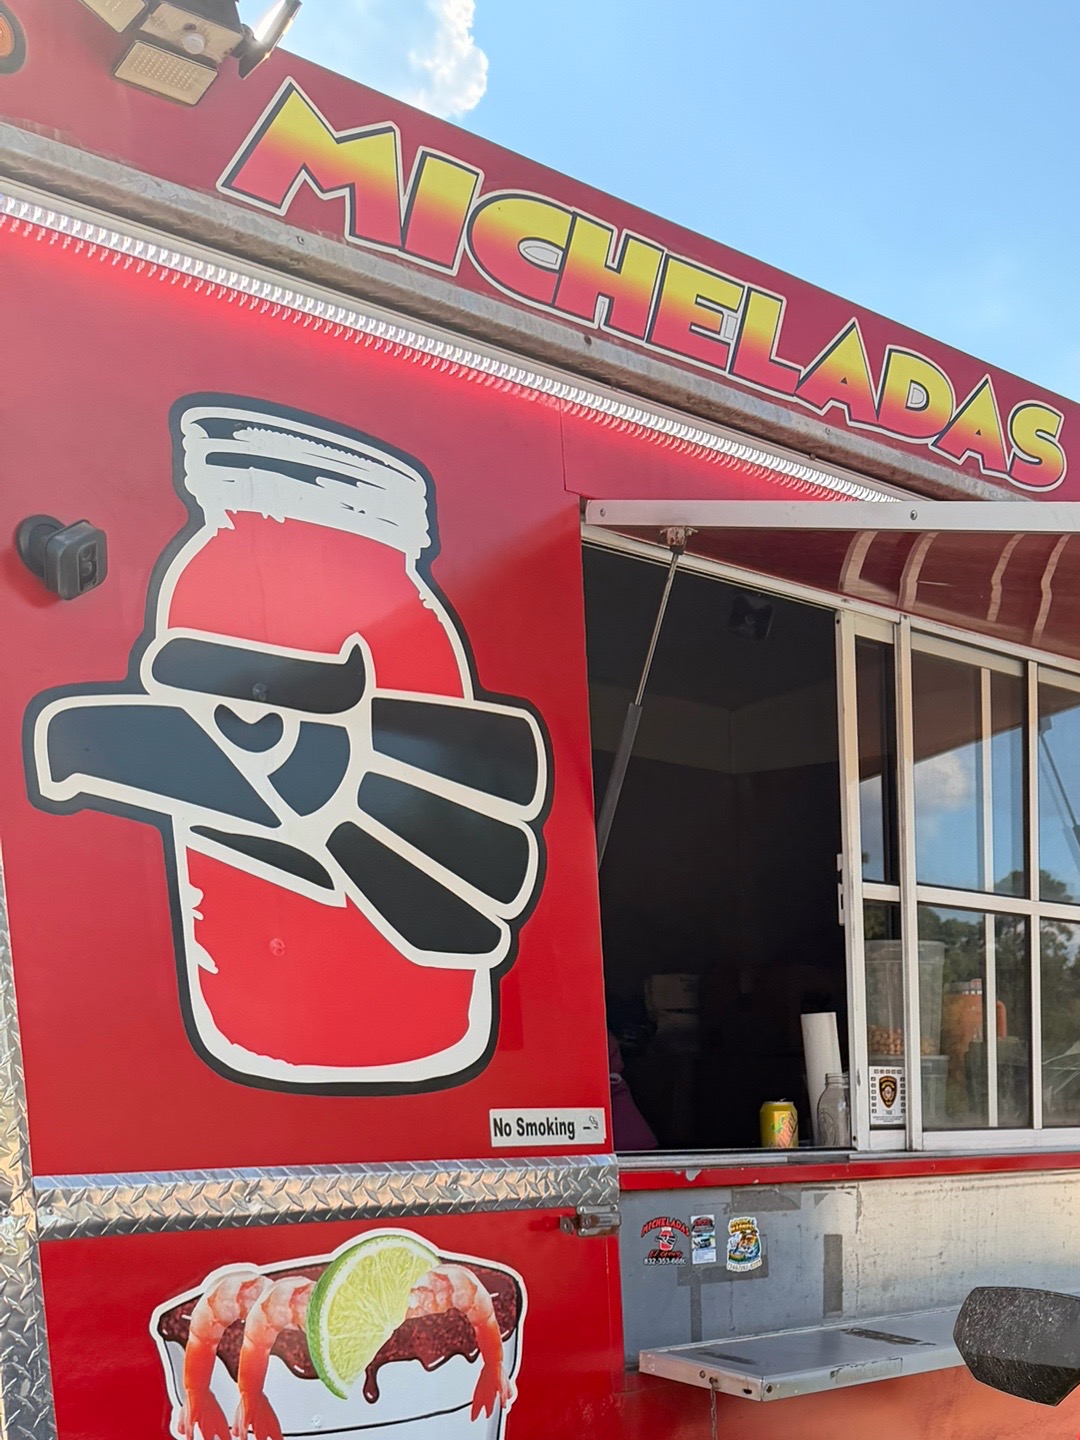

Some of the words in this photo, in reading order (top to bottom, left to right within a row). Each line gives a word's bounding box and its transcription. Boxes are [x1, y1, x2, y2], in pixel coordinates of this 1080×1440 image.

[217, 77, 1067, 492] MICHELADAS
[493, 1117, 512, 1138] No
[517, 1117, 576, 1140] Smoking
[641, 1217, 690, 1238] MICHELADAS
